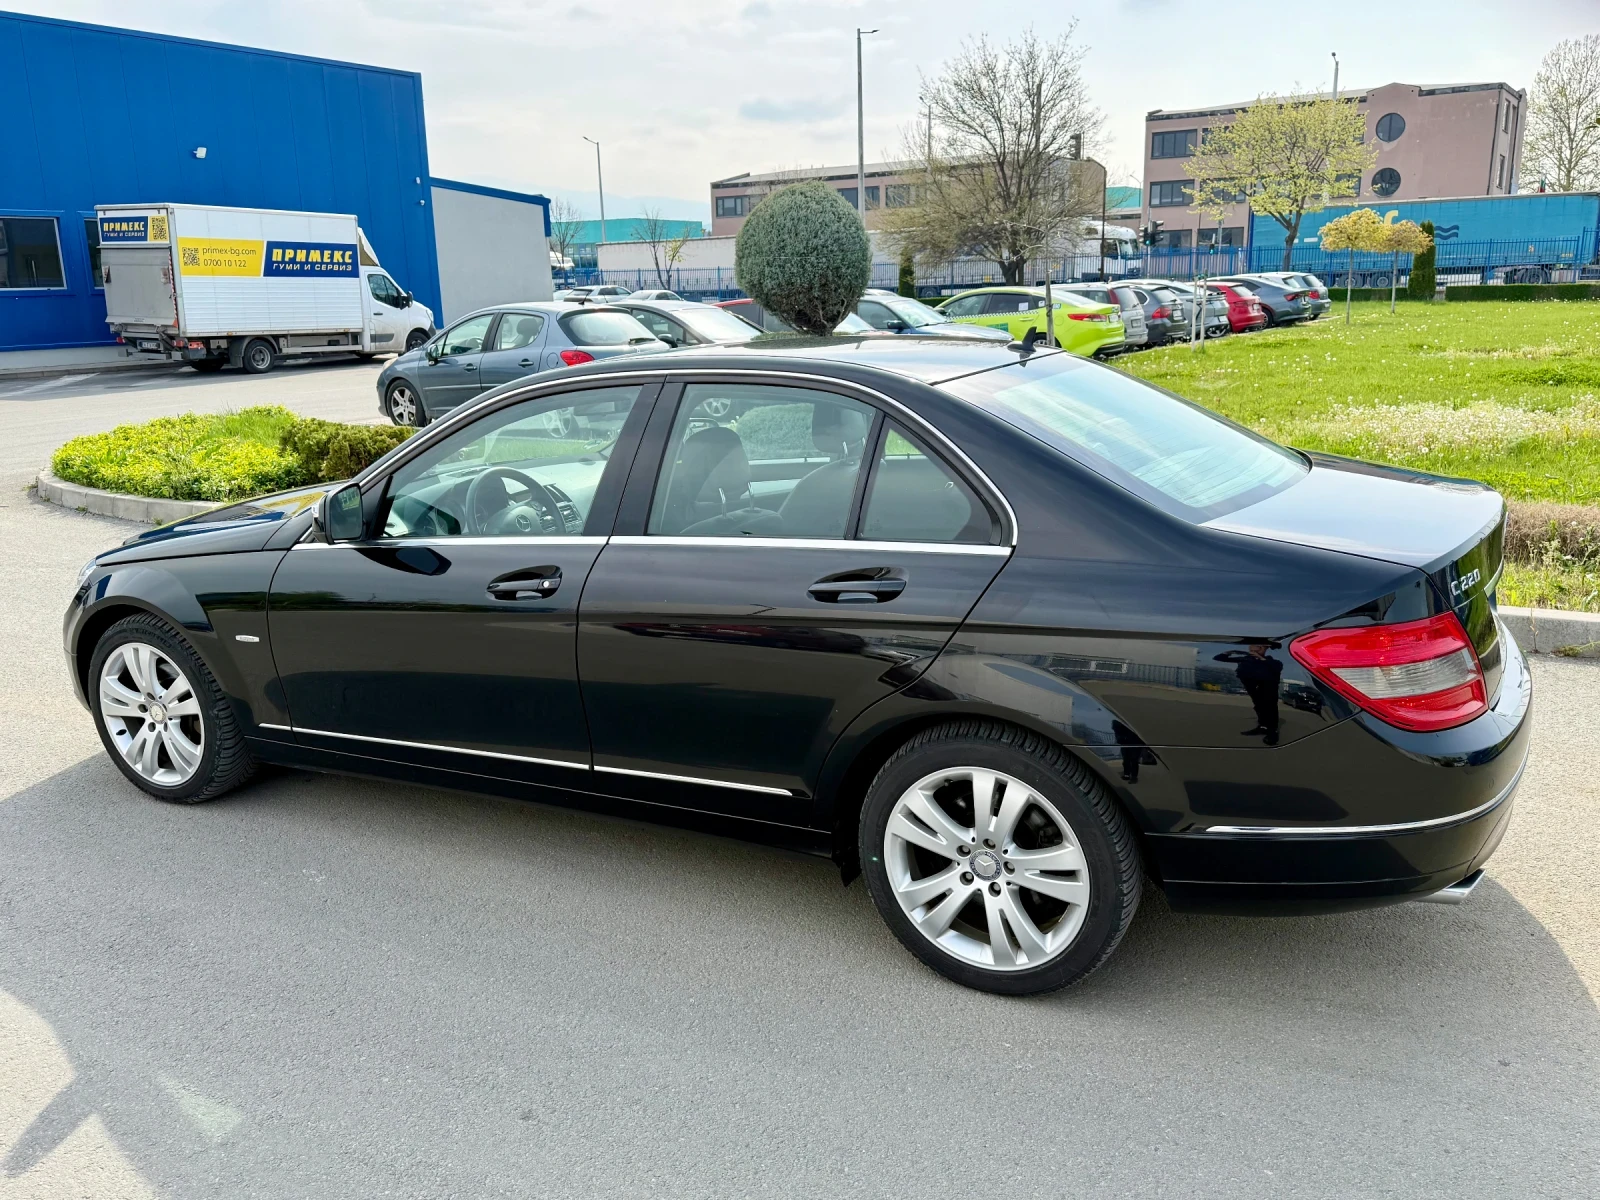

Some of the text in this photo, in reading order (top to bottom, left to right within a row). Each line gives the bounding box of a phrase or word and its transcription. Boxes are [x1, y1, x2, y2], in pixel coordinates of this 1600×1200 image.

[103, 221, 145, 232] ПРИМЕКС
[202, 246, 257, 256] primex-bg.com
[271, 248, 353, 263] ПРИМЕКС
[203, 258, 247, 268] 0700 10 122
[1451, 568, 1481, 596] C 220
